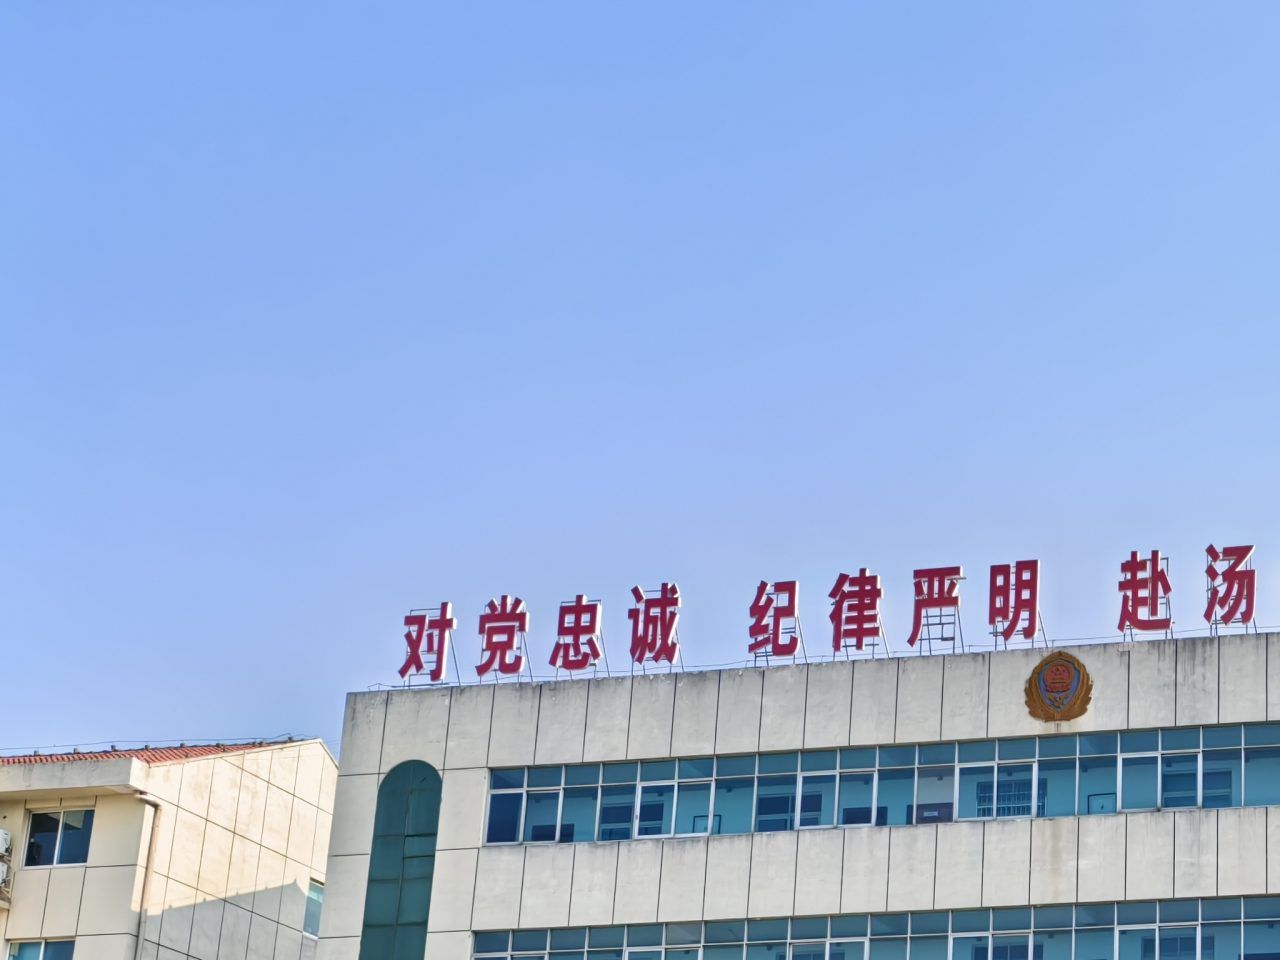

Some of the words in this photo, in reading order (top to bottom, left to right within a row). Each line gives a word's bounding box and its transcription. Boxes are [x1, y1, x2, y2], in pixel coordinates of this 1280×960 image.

[399, 582, 681, 681] 对党忠诚
[749, 560, 1040, 656] 纪律严明
